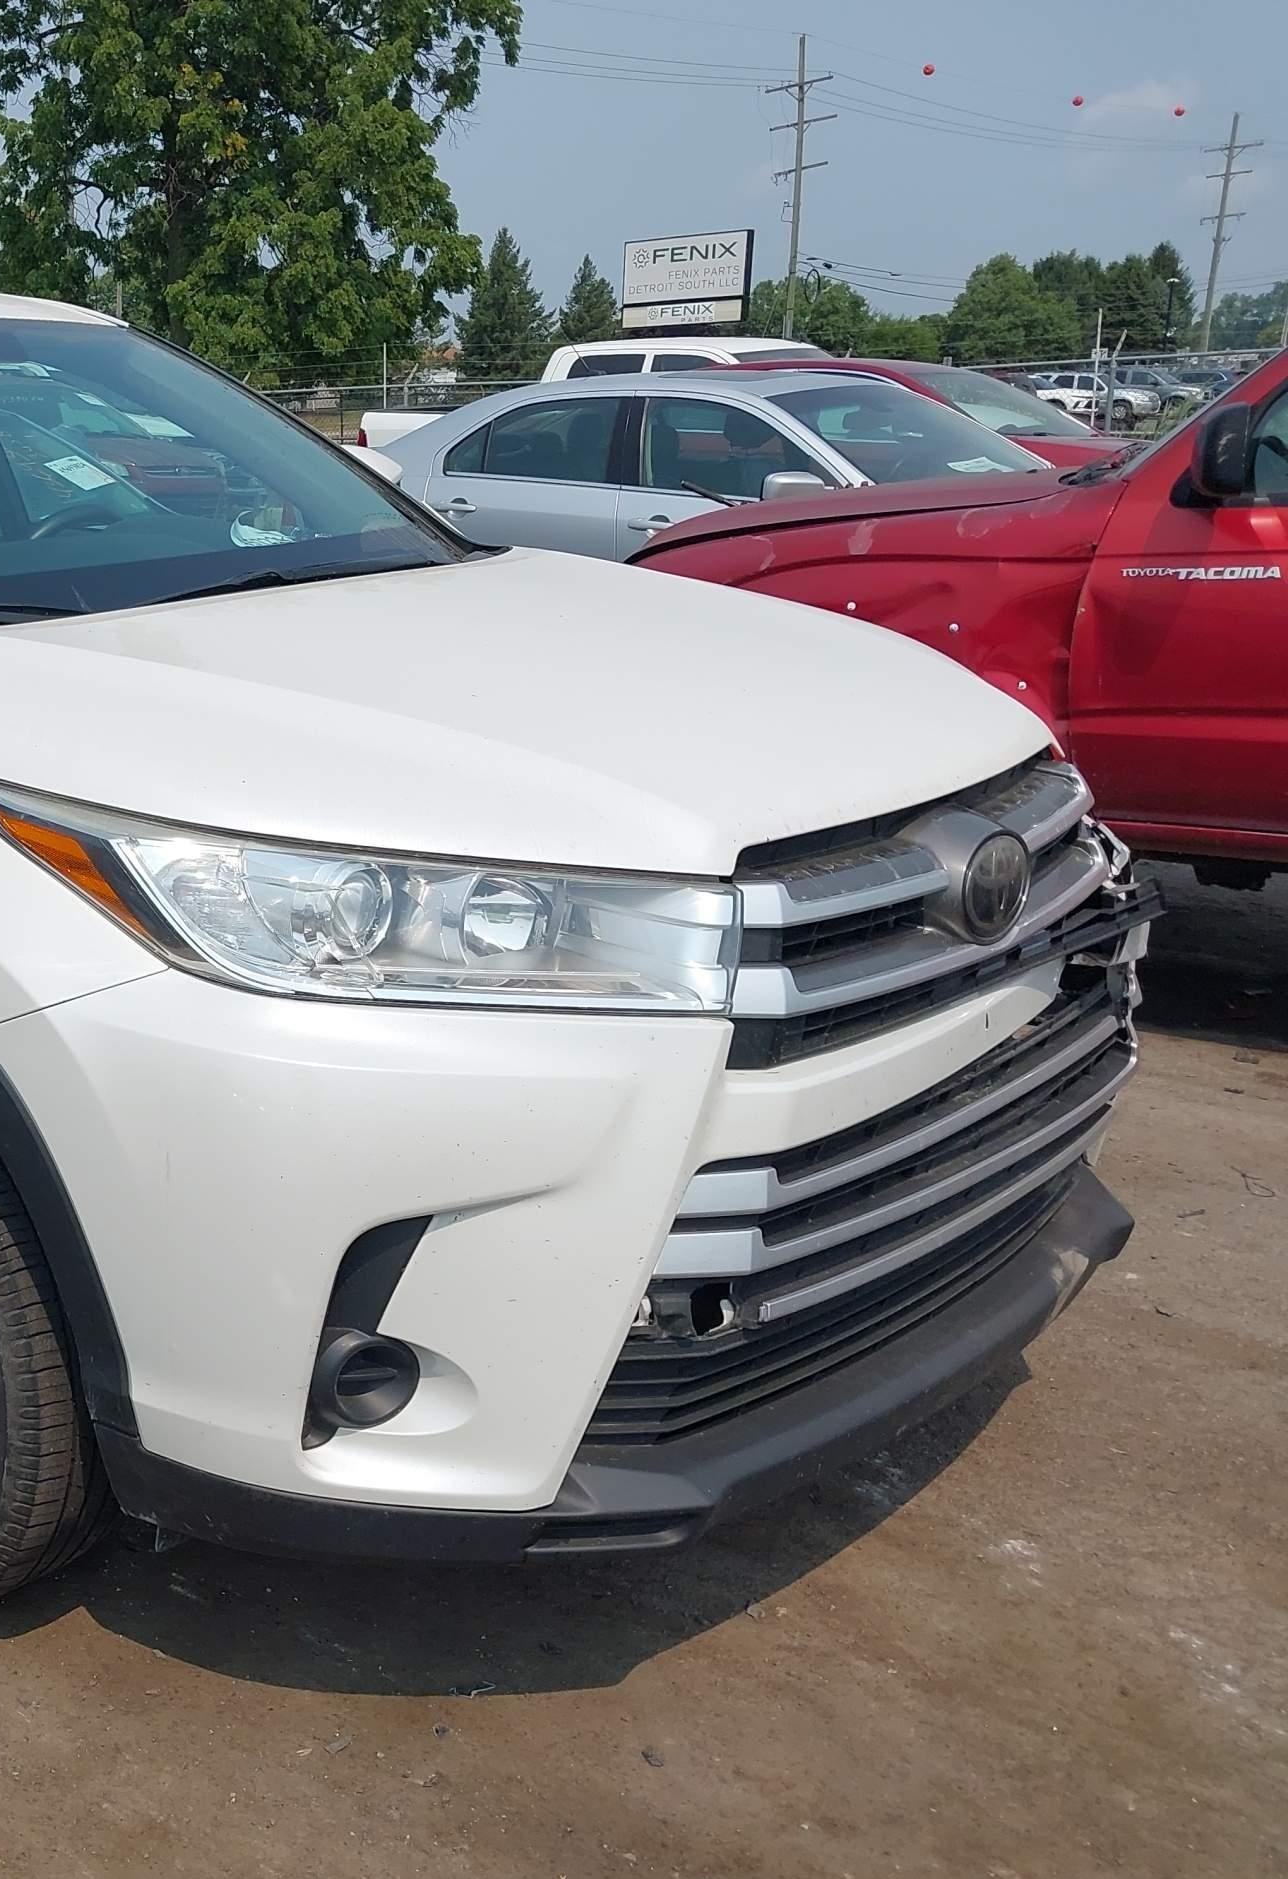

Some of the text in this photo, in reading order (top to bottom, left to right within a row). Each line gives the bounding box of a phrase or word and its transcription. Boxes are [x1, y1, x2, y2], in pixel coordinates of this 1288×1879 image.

[652, 241, 738, 265] FENIX
[668, 265, 740, 281] FENIX PARTS
[628, 277, 739, 295] DETROIT SOUTH LLC
[660, 303, 713, 318] FENIX
[1120, 566, 1282, 580] TOYOTA TACOMA
